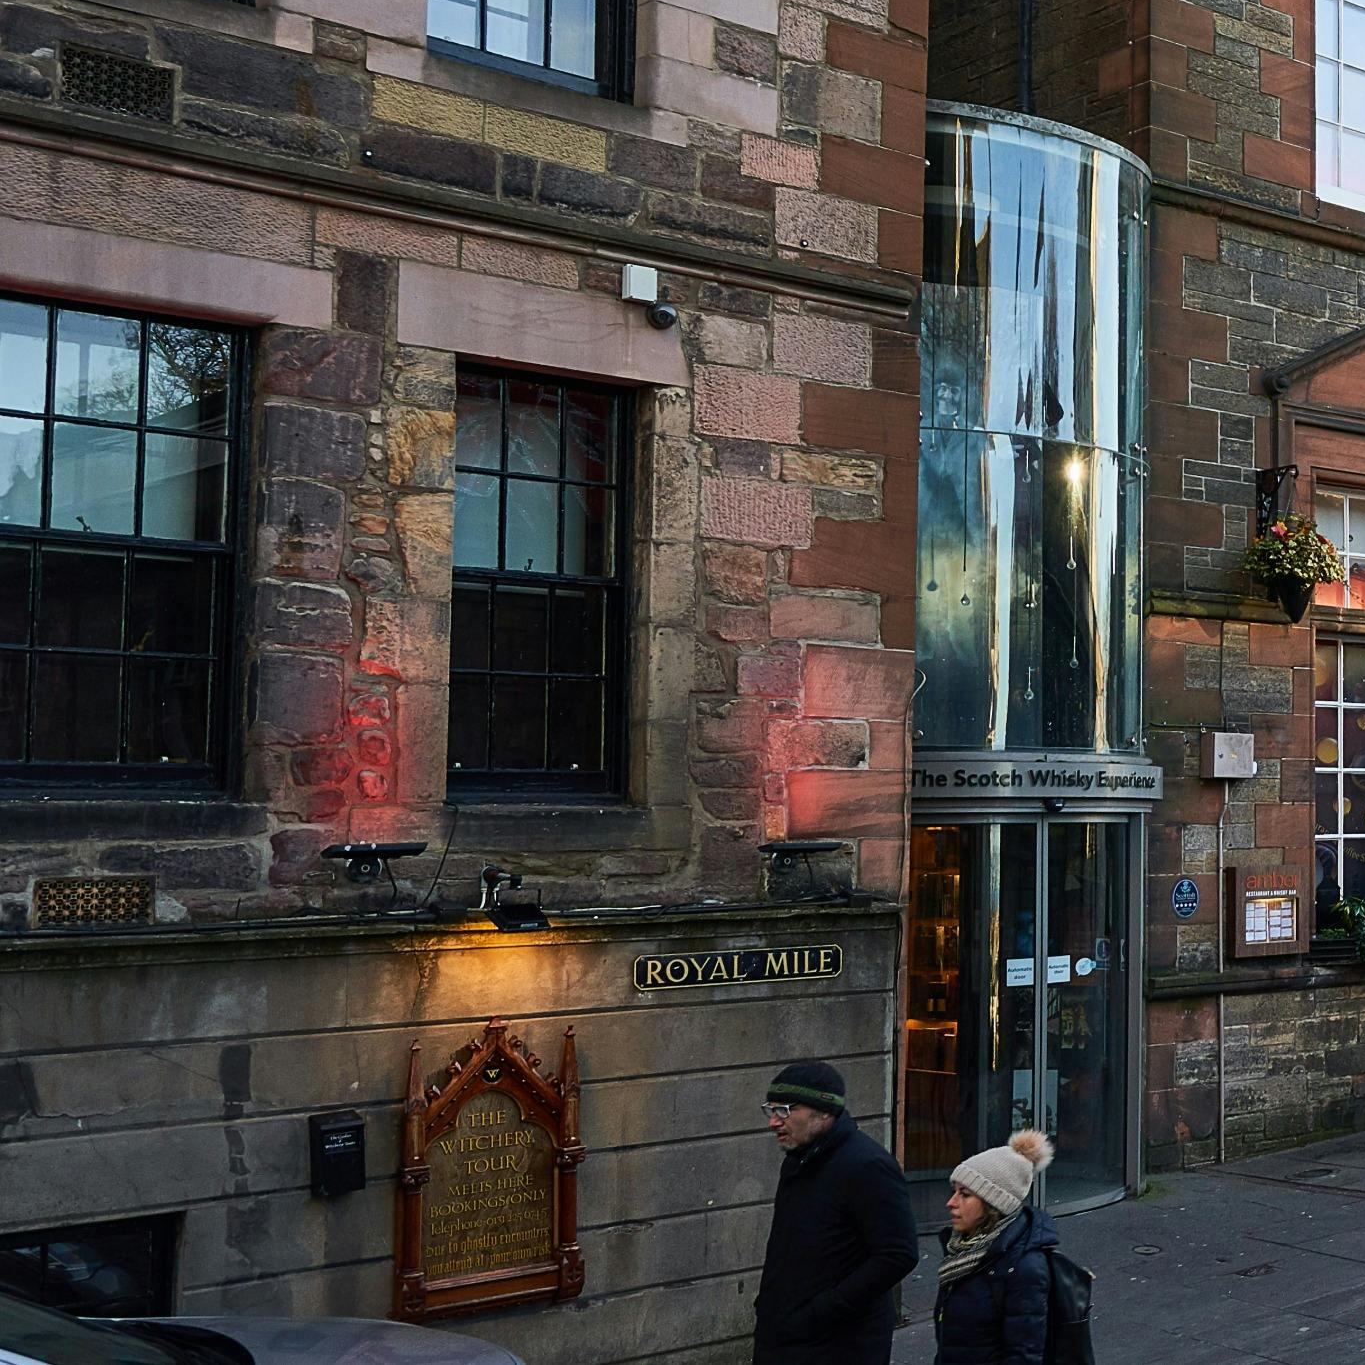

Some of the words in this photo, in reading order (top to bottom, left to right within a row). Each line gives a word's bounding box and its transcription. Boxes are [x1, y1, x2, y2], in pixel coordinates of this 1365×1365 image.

[911, 769, 947, 787] The
[953, 769, 1022, 787] Scotch
[1028, 769, 1094, 791] Whisky
[1096, 771, 1156, 793] Experience
[646, 955, 748, 985] ROYAL
[764, 949, 833, 977] MILE
[467, 1110, 507, 1128] THE
[438, 1130, 533, 1155] WITCHERY
[464, 1154, 520, 1176] TOUR
[497, 1174, 533, 1190] HERE
